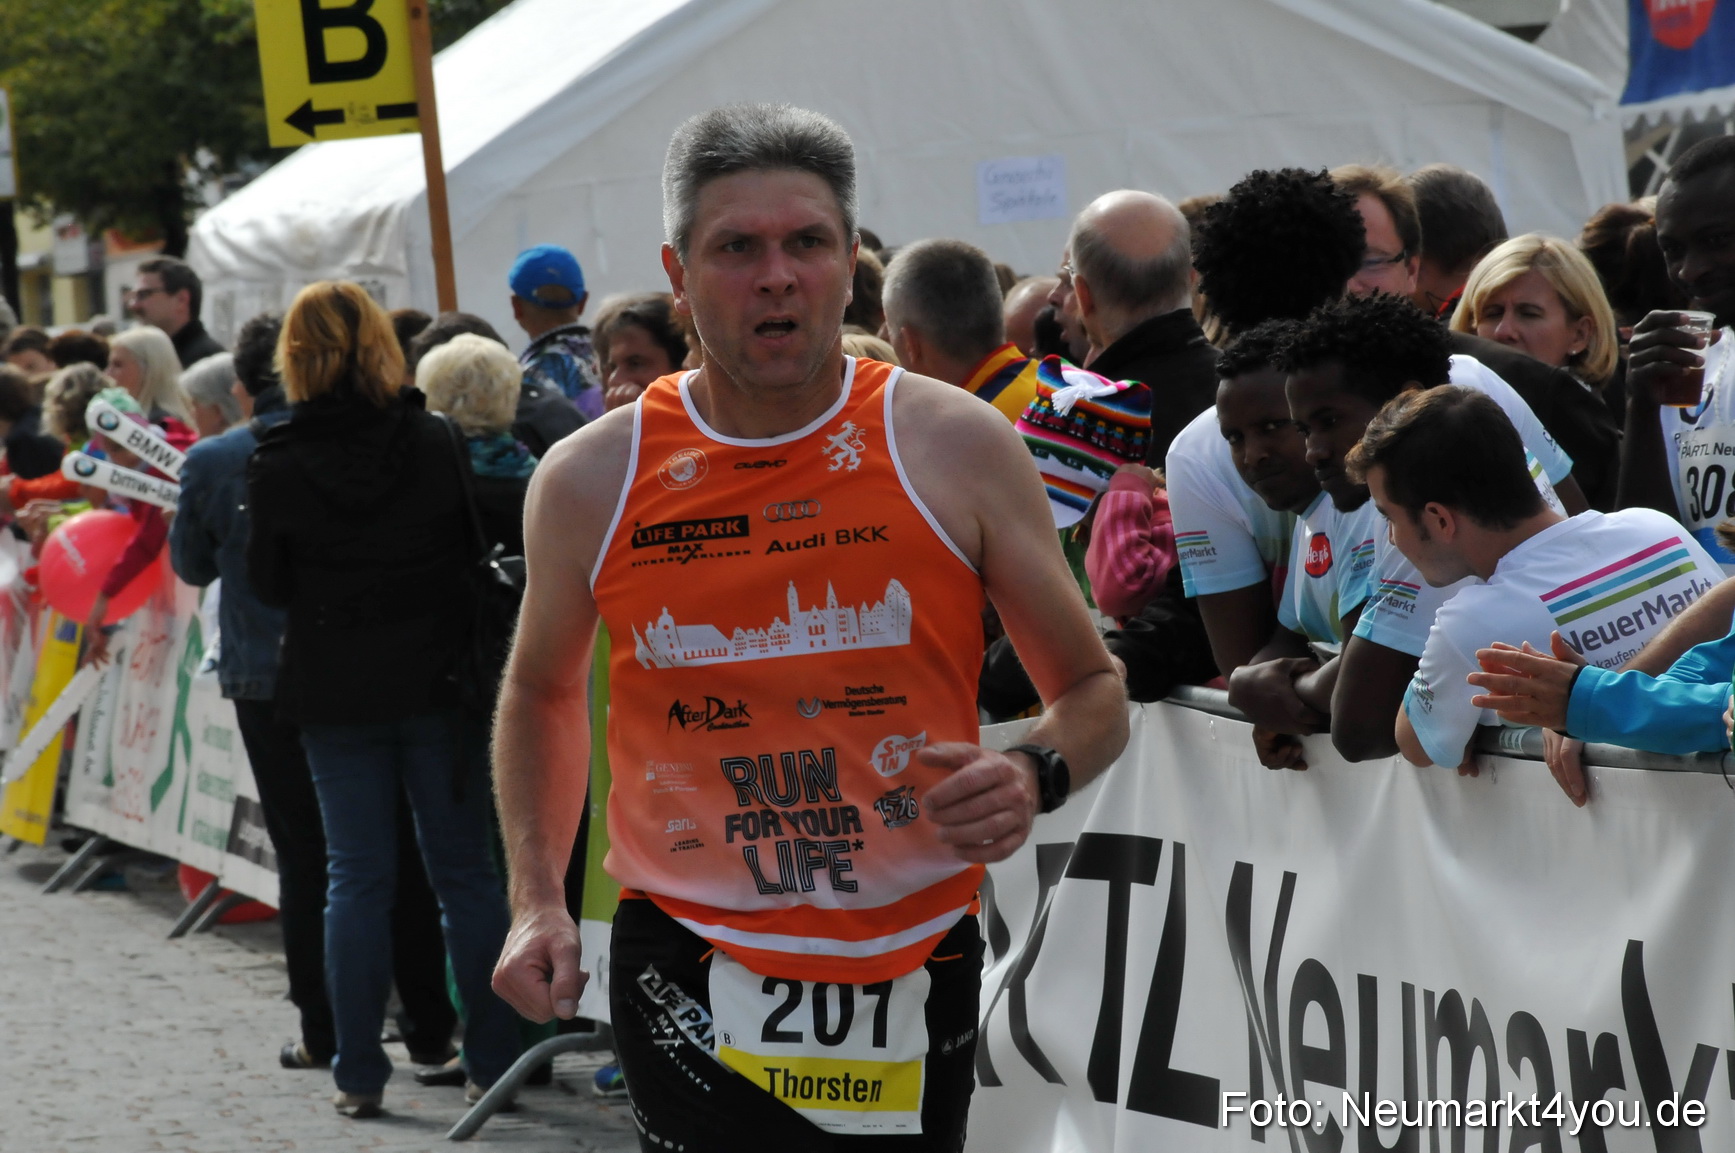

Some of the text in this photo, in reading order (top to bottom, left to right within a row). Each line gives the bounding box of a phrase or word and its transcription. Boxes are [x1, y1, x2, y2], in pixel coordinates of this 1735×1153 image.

[301, 0, 388, 85] B
[127, 428, 178, 467] BMW
[636, 520, 742, 543] LIFE PARK
[765, 525, 890, 555] Audi BKK
[667, 543, 704, 565] MAX
[822, 695, 907, 710] Vermögensberatung
[845, 684, 884, 696] Deutsche
[720, 747, 842, 808] RUN
[725, 805, 864, 843] FOR YOUR
[761, 976, 893, 1048] 207
[1225, 860, 1735, 1153] Neumark
[653, 1013, 685, 1048] MAX
[724, 1032, 732, 1045] B
[955, 1028, 974, 1049] JAKO
[763, 1066, 882, 1103] Thorsten
